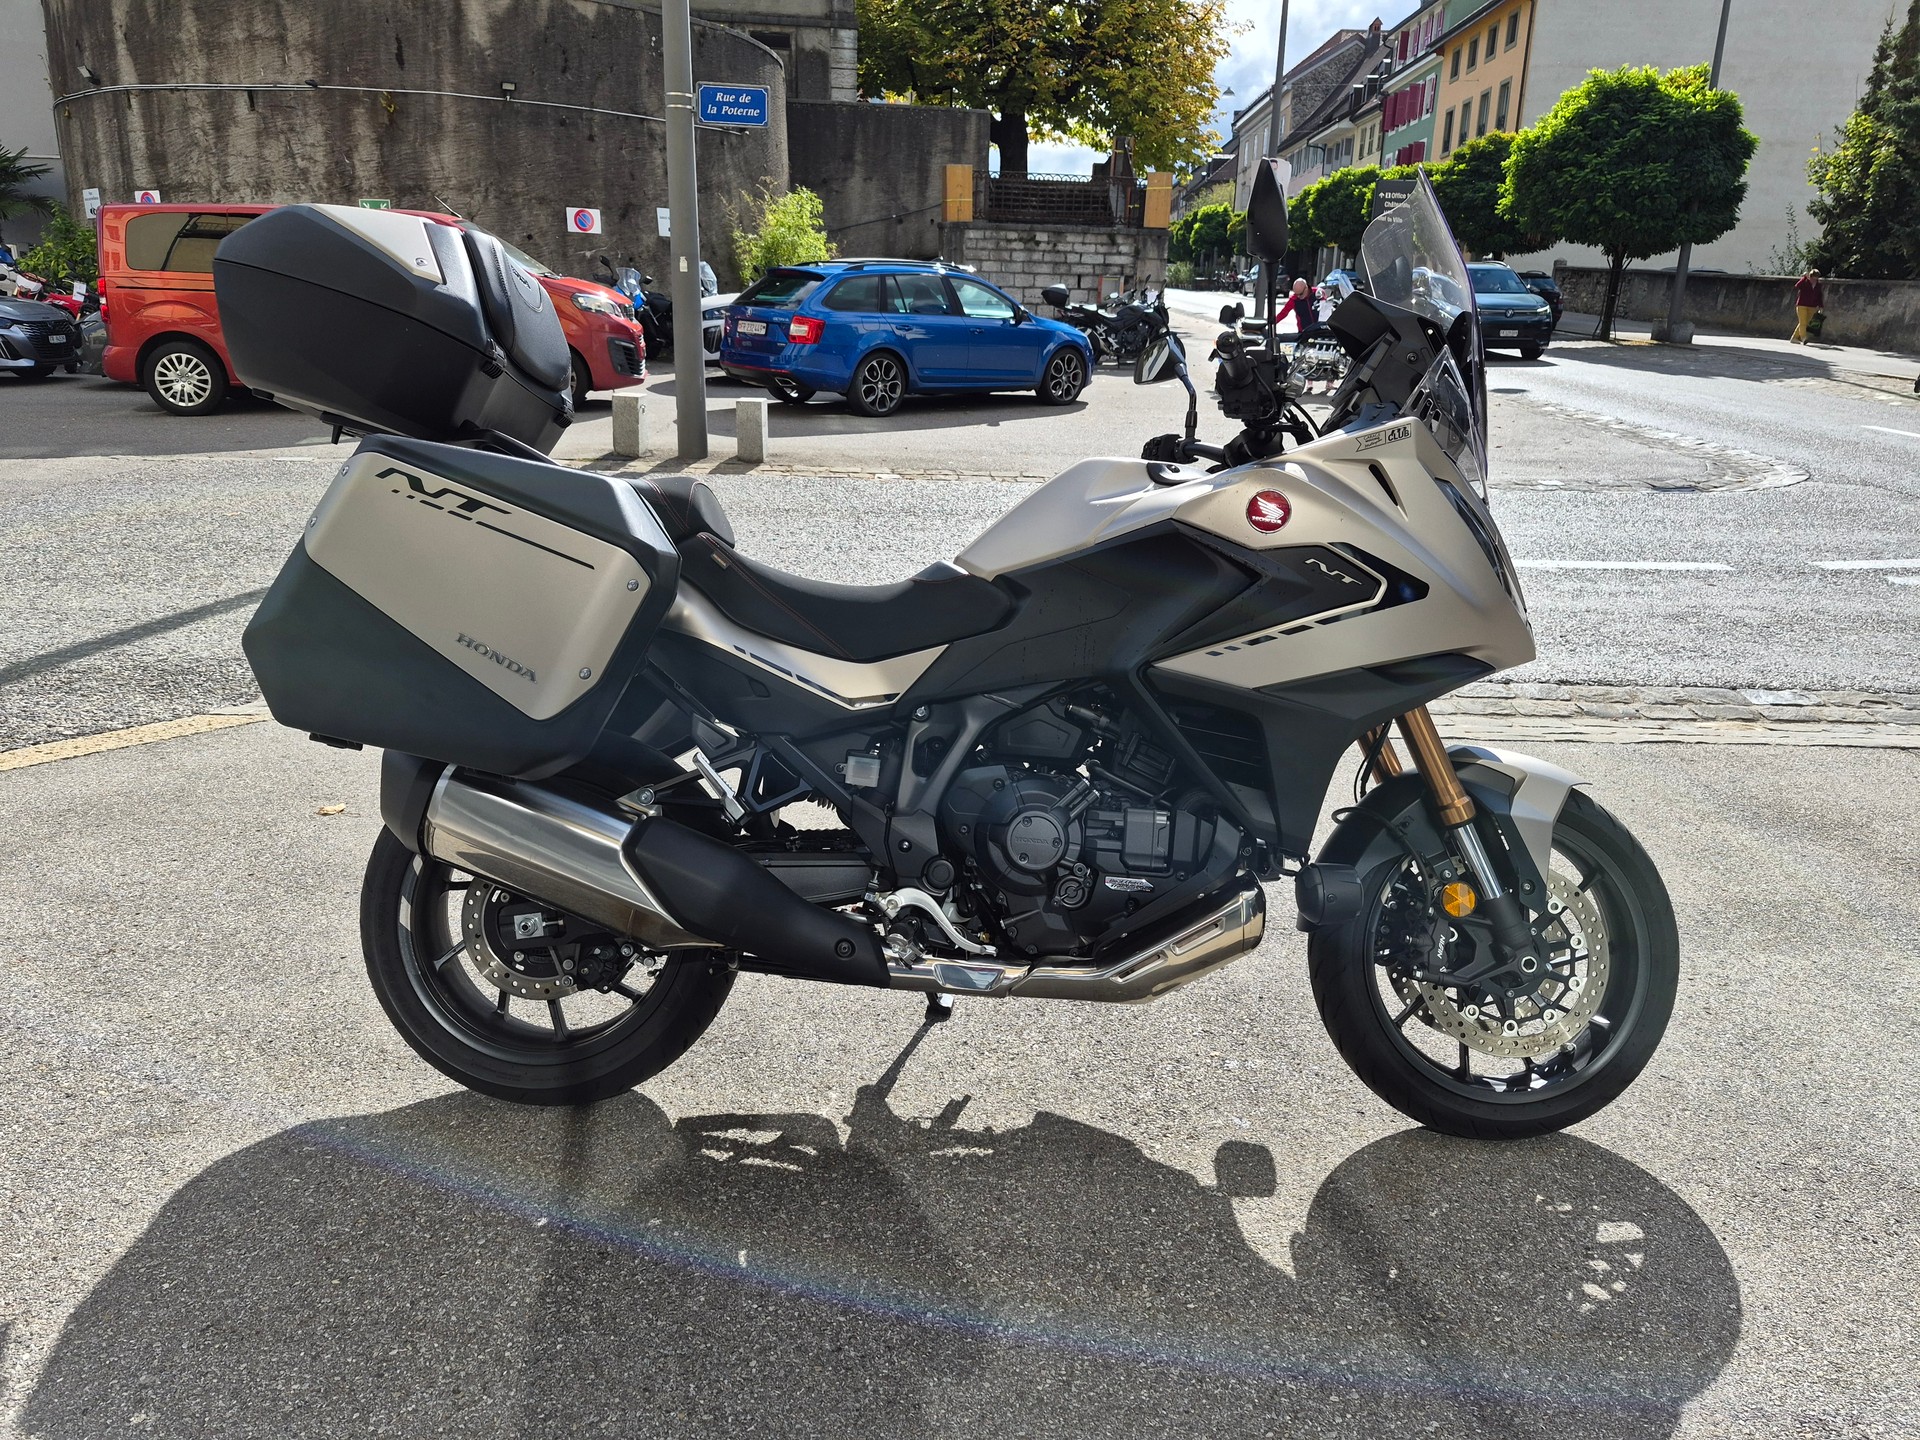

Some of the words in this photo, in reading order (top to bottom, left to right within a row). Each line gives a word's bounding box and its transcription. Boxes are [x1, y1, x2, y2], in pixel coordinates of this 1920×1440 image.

[716, 92, 735, 102] Rue
[739, 93, 751, 103] de
[707, 104, 717, 114] la
[721, 105, 760, 117] Poterne
[1388, 427, 1410, 441] CLUB
[456, 632, 537, 683] HONDA
